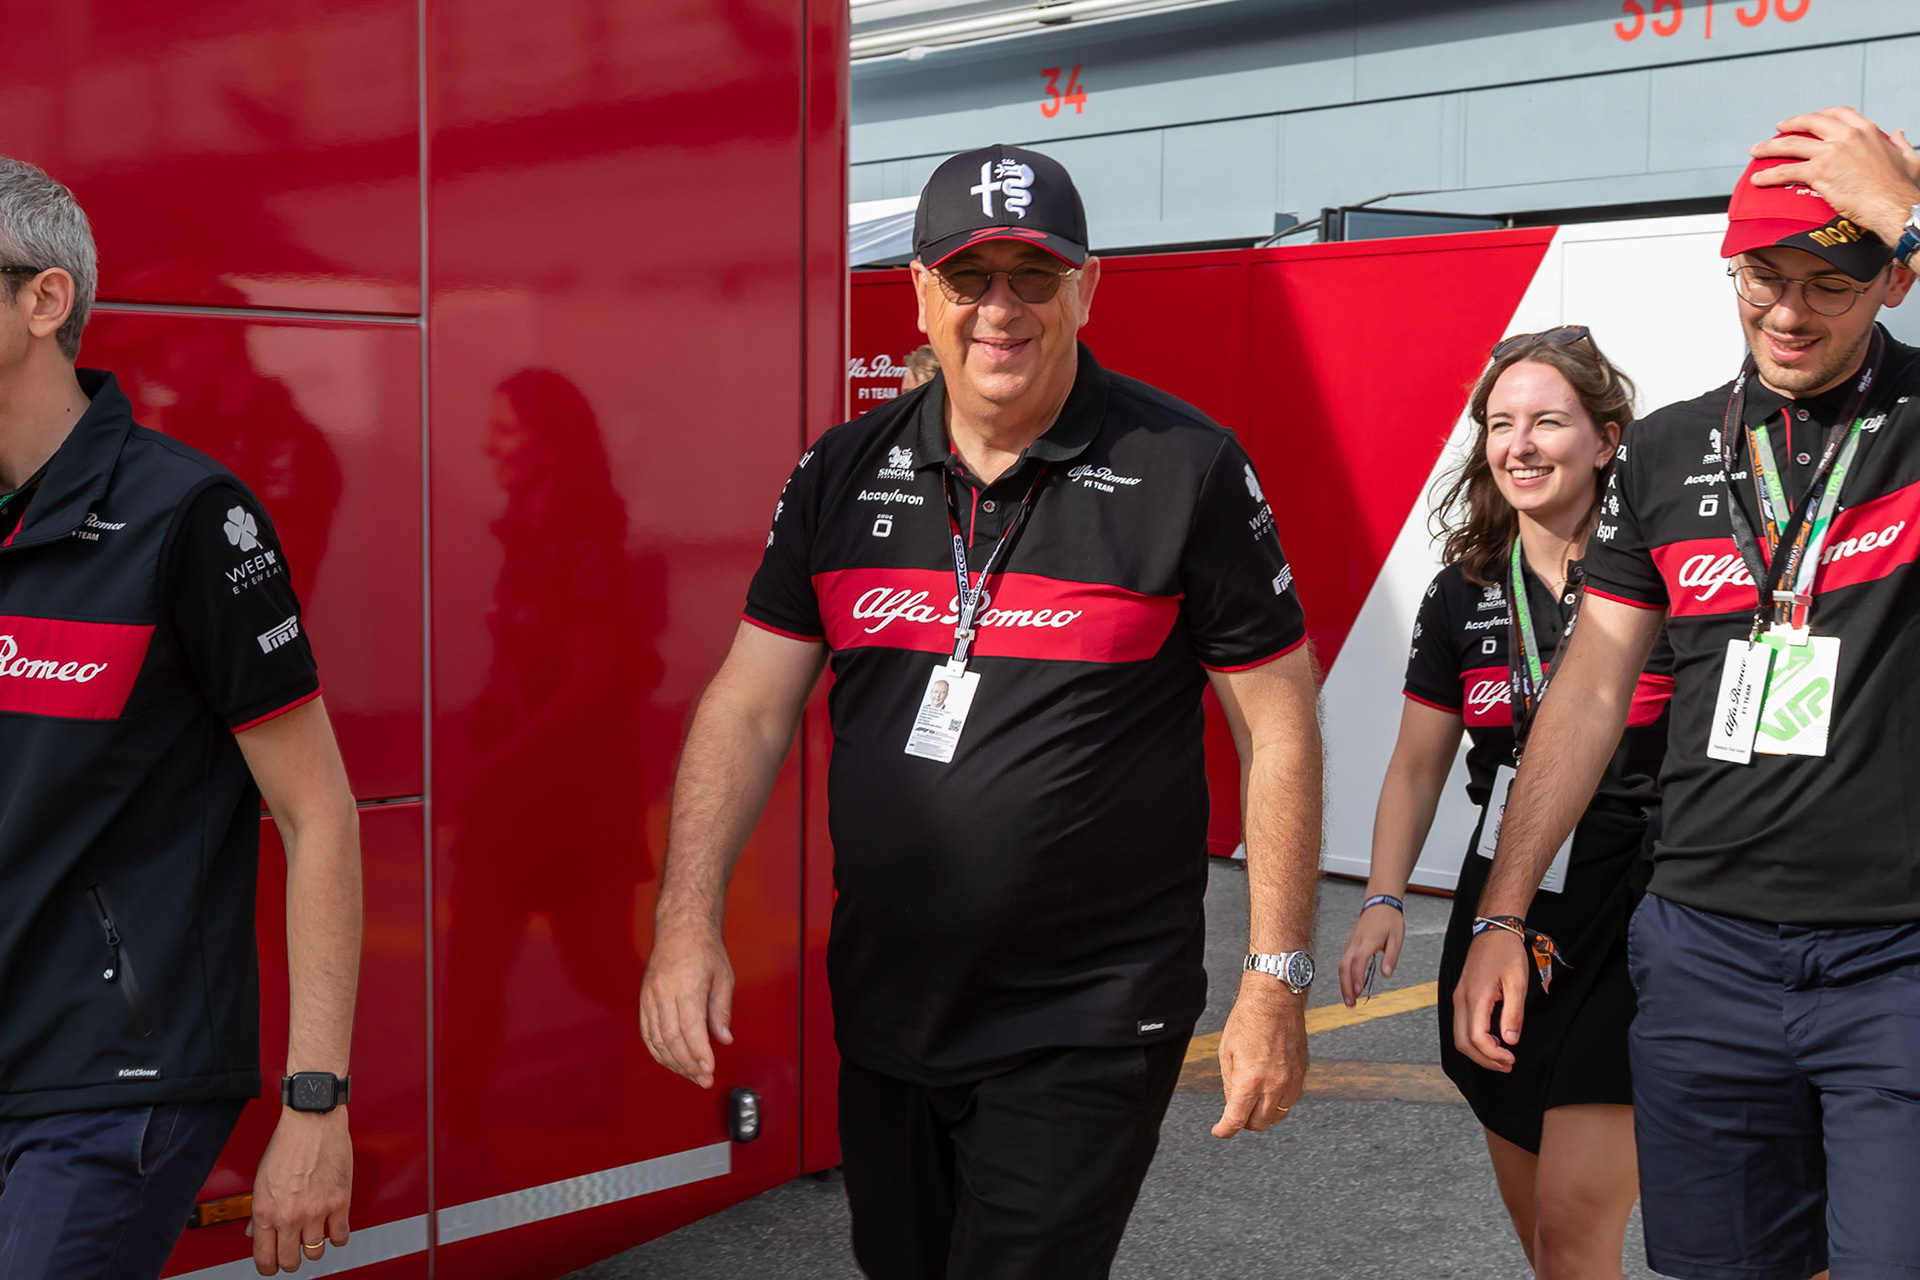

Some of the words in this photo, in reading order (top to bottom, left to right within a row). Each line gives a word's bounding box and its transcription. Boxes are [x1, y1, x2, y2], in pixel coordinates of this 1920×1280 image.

[1040, 64, 1088, 119] 34
[858, 388, 870, 399] F1
[871, 388, 898, 399] TEAM
[878, 468, 915, 478] SINGHA
[1093, 467, 1143, 486] Romeo
[1083, 480, 1094, 488] F1
[1093, 481, 1115, 493] TEAM
[77, 530, 100, 541] TEAM
[955, 537, 967, 578] ACCESS
[225, 554, 266, 583] WEB
[852, 587, 942, 634] Alfa
[1477, 598, 1508, 609] SINGHA
[1729, 658, 1748, 705] Romeo
[1743, 684, 1752, 704] TEAM
[1724, 705, 1739, 738] Alfa
